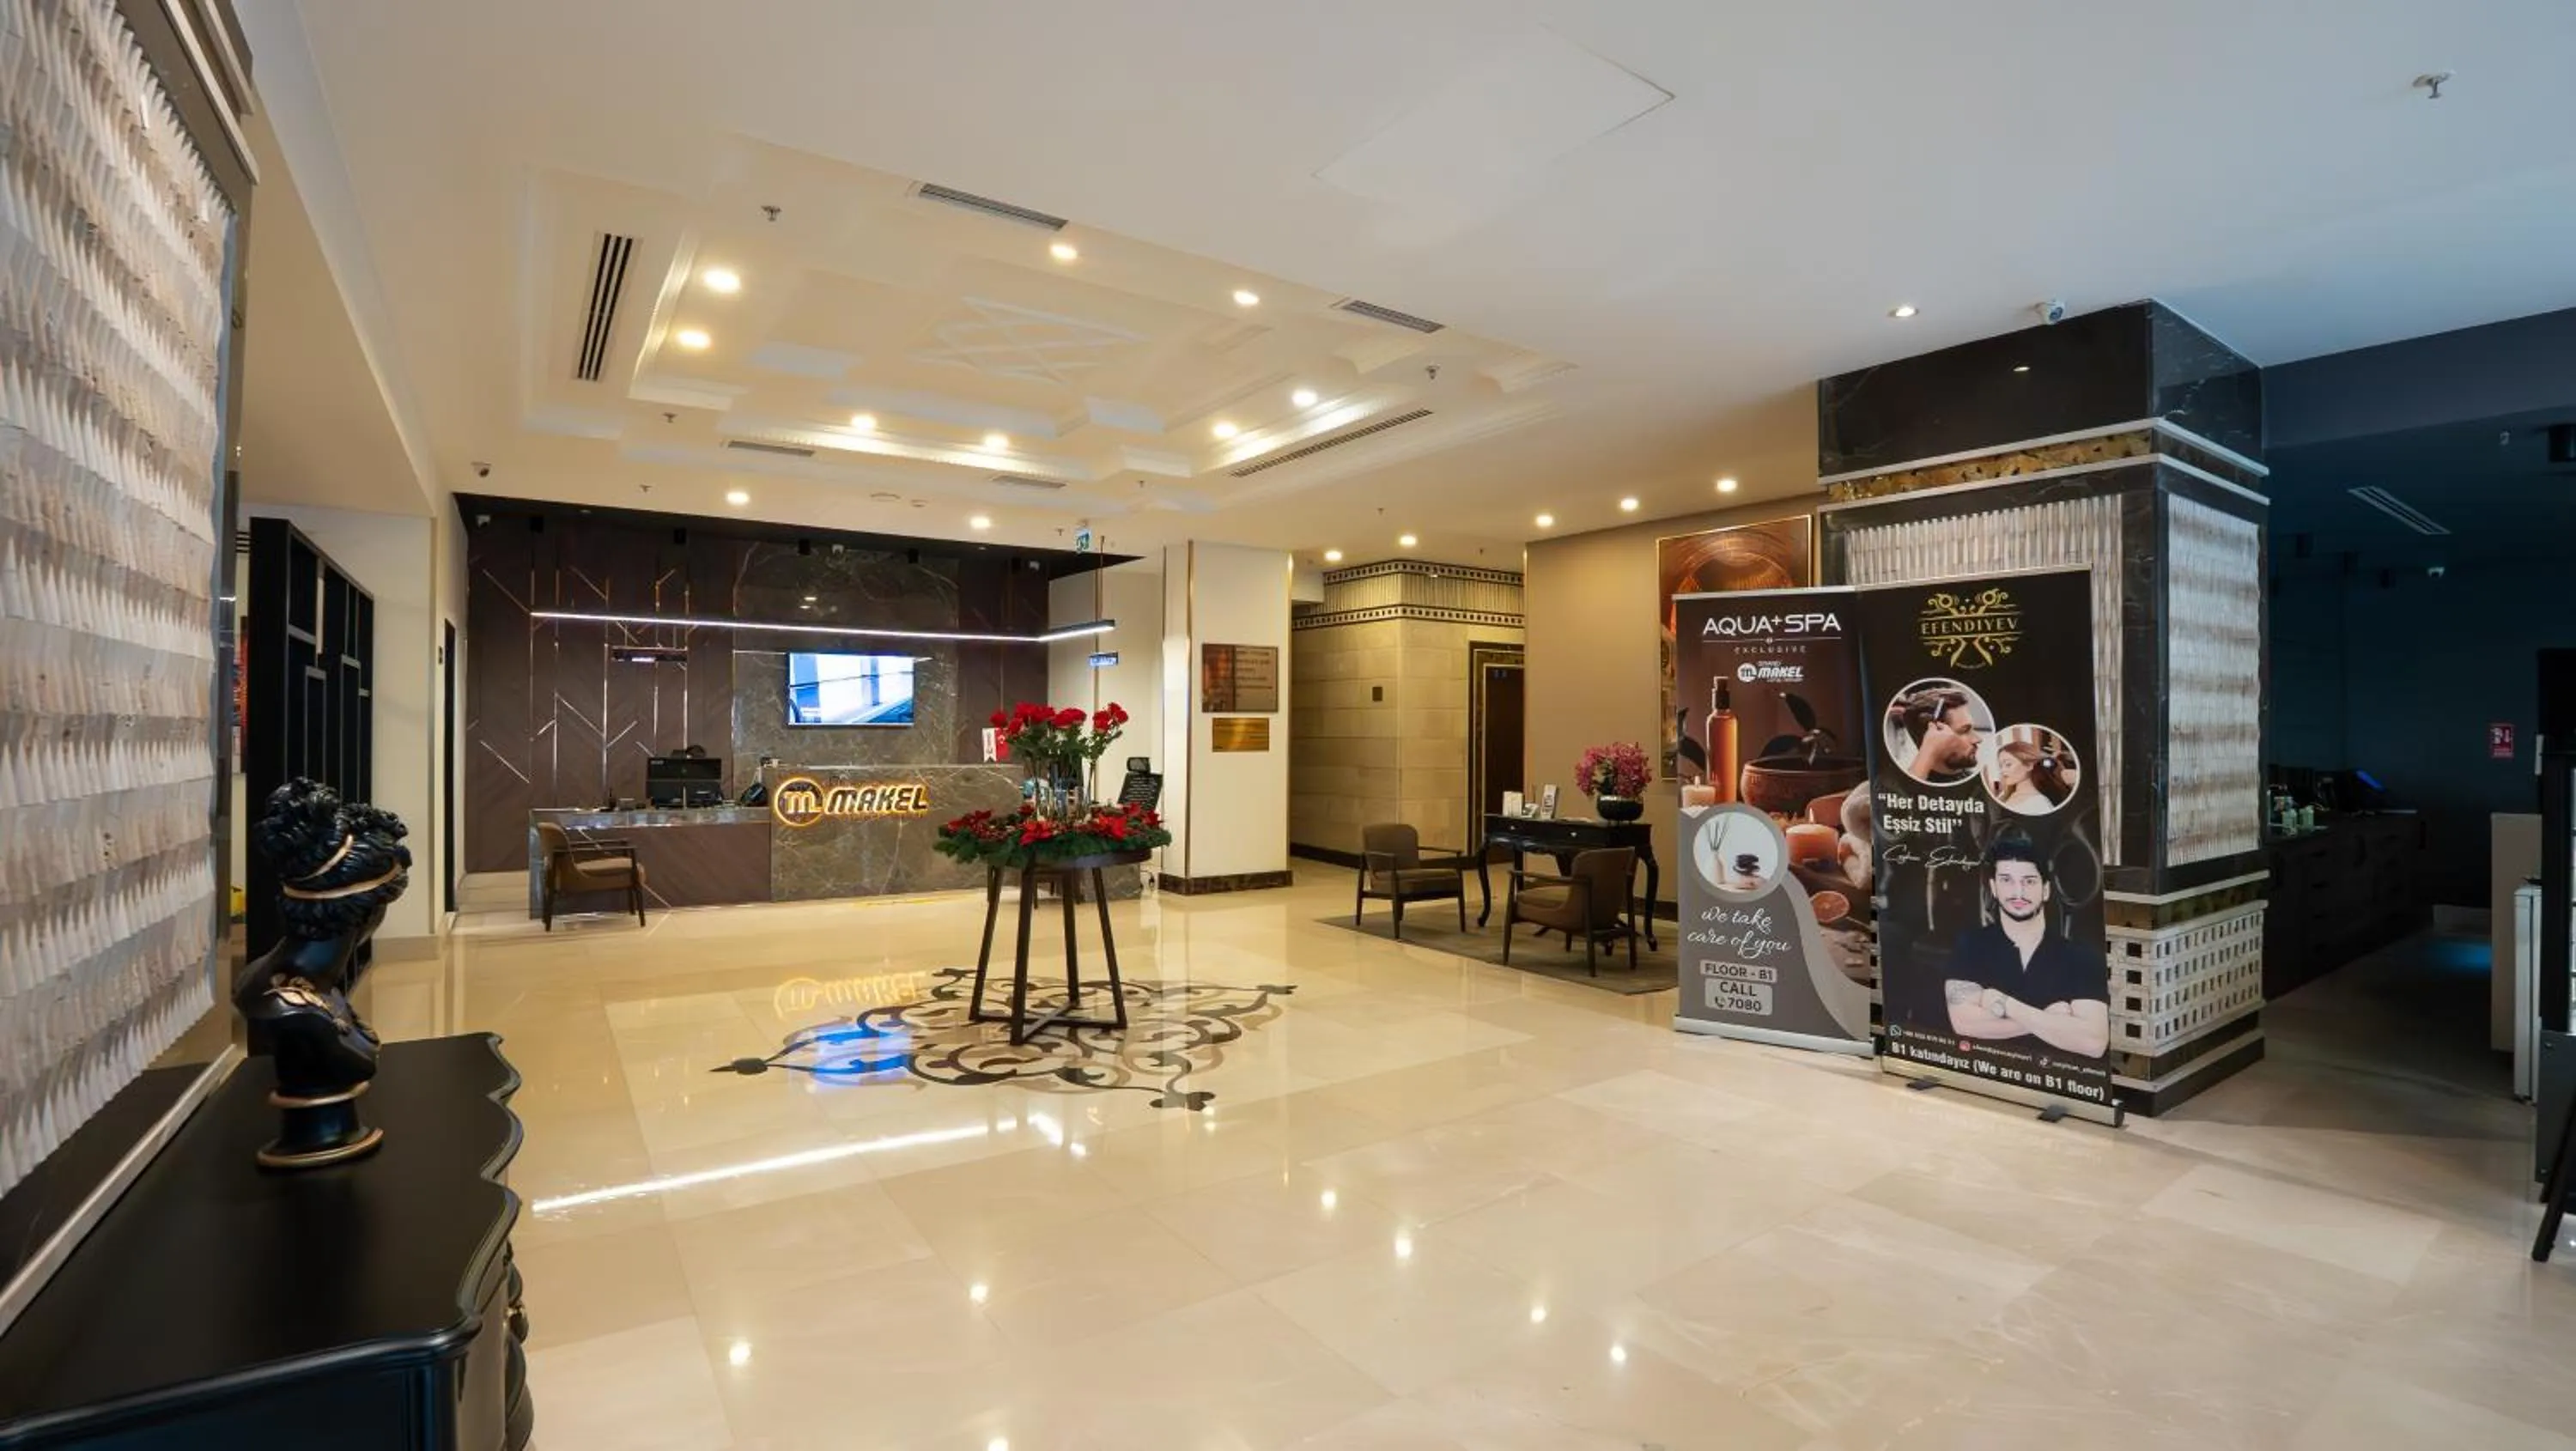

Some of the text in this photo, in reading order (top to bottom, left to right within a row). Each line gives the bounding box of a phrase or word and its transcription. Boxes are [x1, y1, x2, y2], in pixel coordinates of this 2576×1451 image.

[1920, 617, 2019, 634] EFENDIYEV
[1734, 645, 1807, 654] EXCLUSIVE
[1758, 666, 1804, 678] MAKEL
[824, 785, 929, 816] MAKEL
[1917, 795, 1984, 815] Detayda
[1883, 816, 1921, 834] Eşsiz
[1732, 908, 1773, 934] take
[1686, 928, 1792, 959] care of you
[1704, 962, 1748, 978] FLOOR
[1759, 968, 1773, 981] B1
[1720, 981, 1758, 997] CALL
[1728, 997, 1762, 1011] 7080
[1892, 1041, 1906, 1055] B1
[1973, 1059, 1997, 1076] (We
[2001, 1067, 2021, 1080] are
[2025, 1073, 2041, 1085] on
[2045, 1075, 2062, 1090] B1
[2068, 1079, 2105, 1102] floor)
